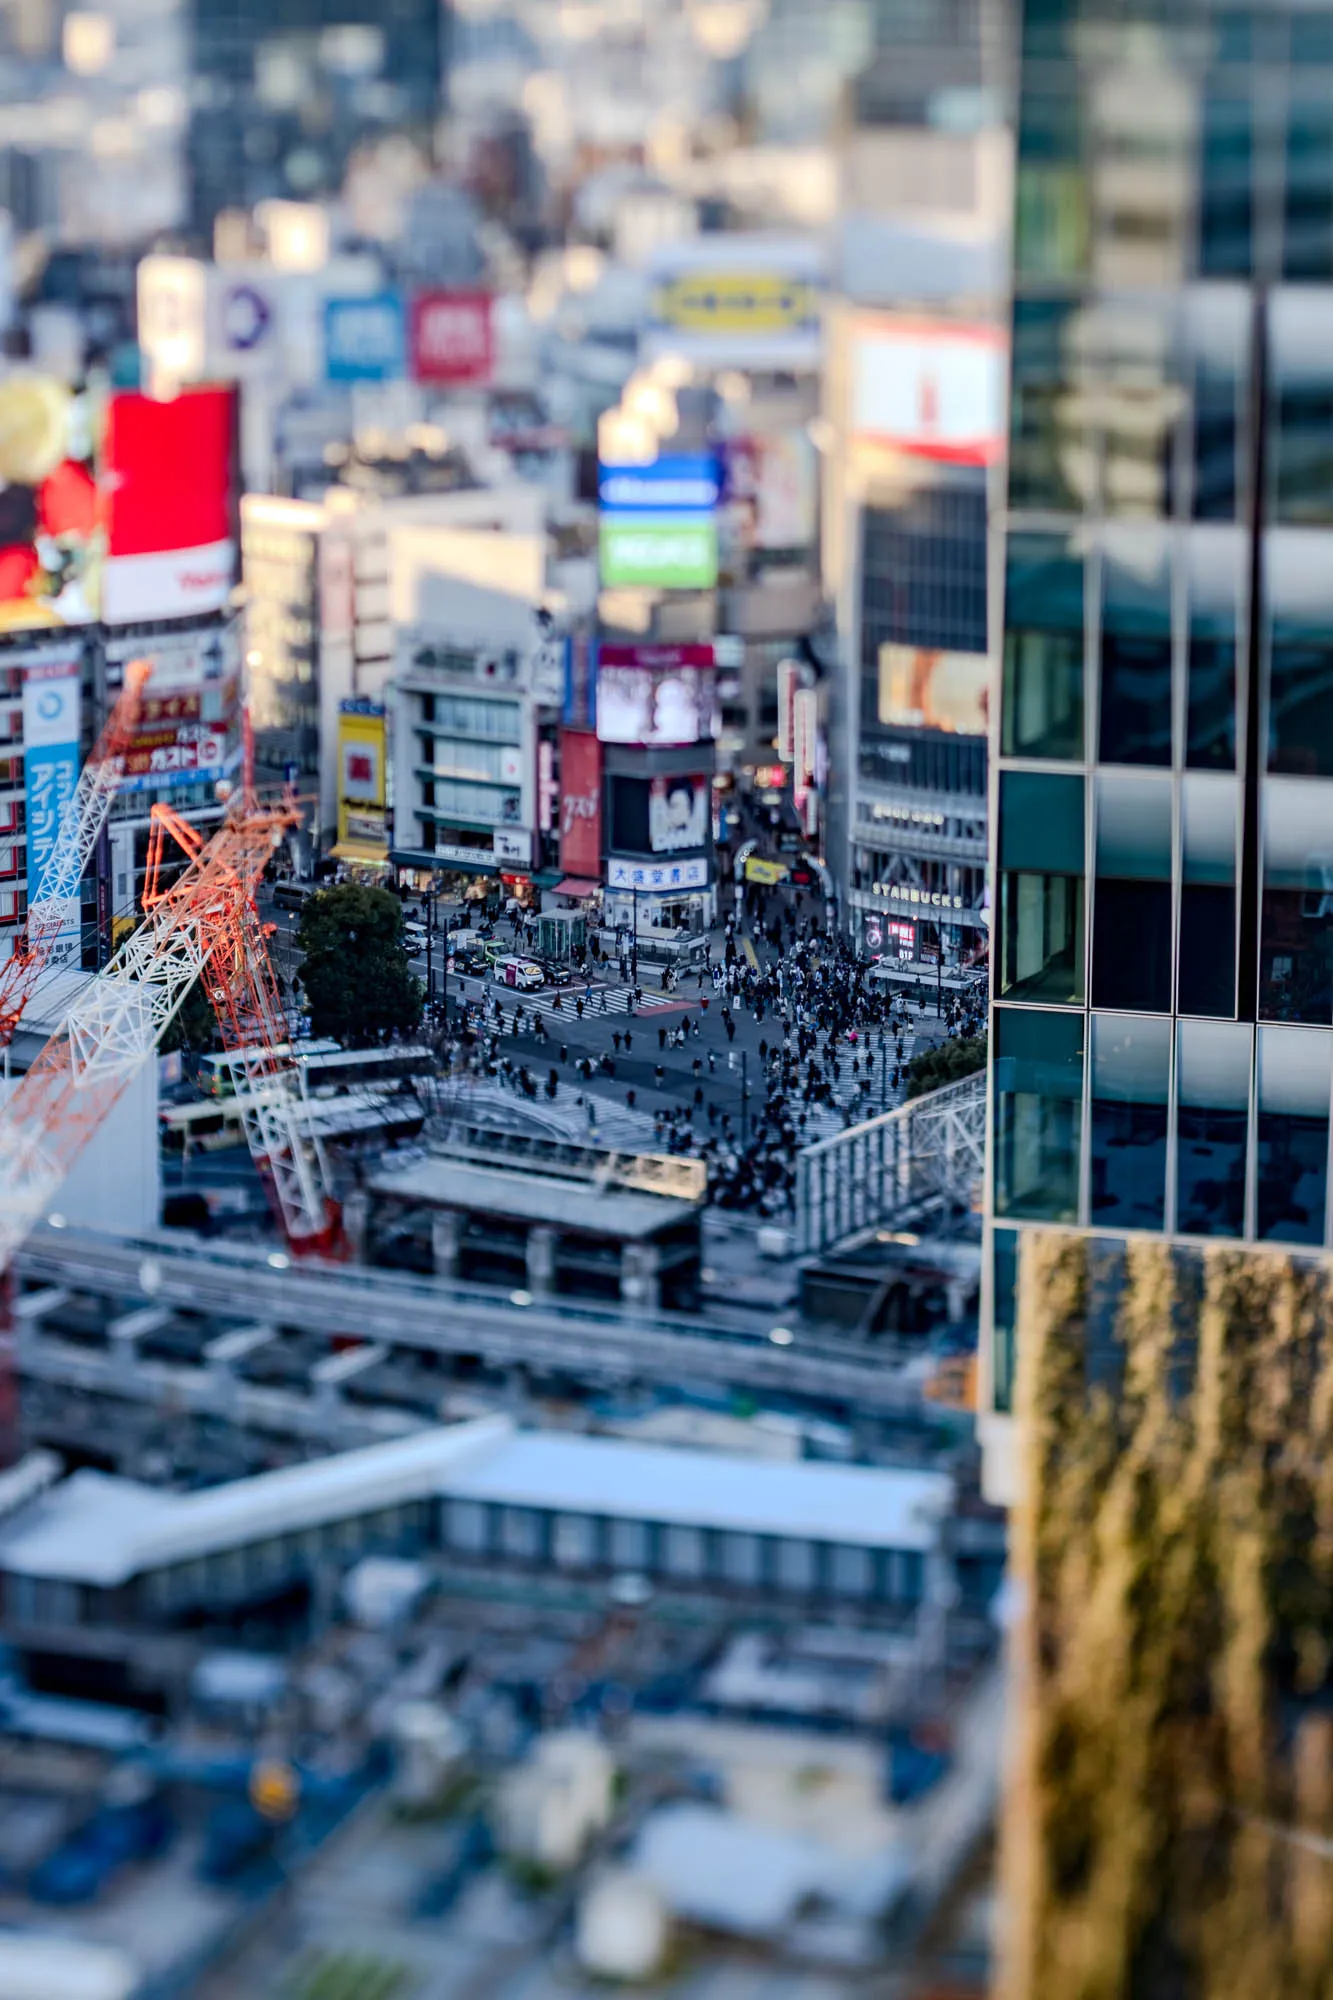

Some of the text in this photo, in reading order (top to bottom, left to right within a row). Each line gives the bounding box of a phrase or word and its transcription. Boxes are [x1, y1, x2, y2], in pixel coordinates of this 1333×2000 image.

[150, 747, 196, 773] ガスト
[615, 866, 700, 885] 大盛堂書店
[873, 882, 963, 909] STARBUCKS
